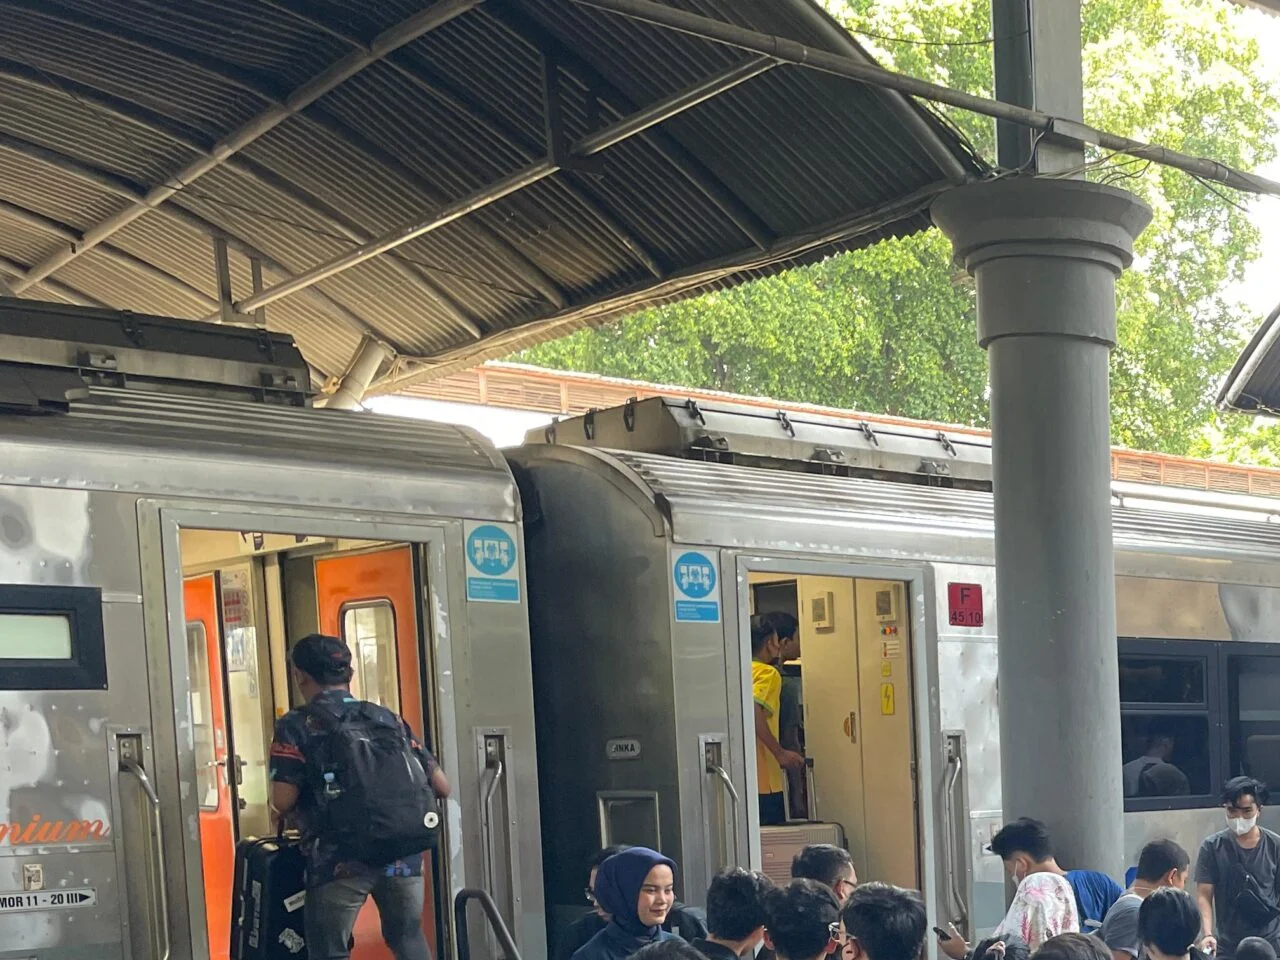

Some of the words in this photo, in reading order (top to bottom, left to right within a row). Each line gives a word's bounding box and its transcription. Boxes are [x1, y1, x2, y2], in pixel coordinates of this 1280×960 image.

[960, 587, 971, 604] F
[26, 895, 38, 907] 11
[50, 893, 64, 905] 20
